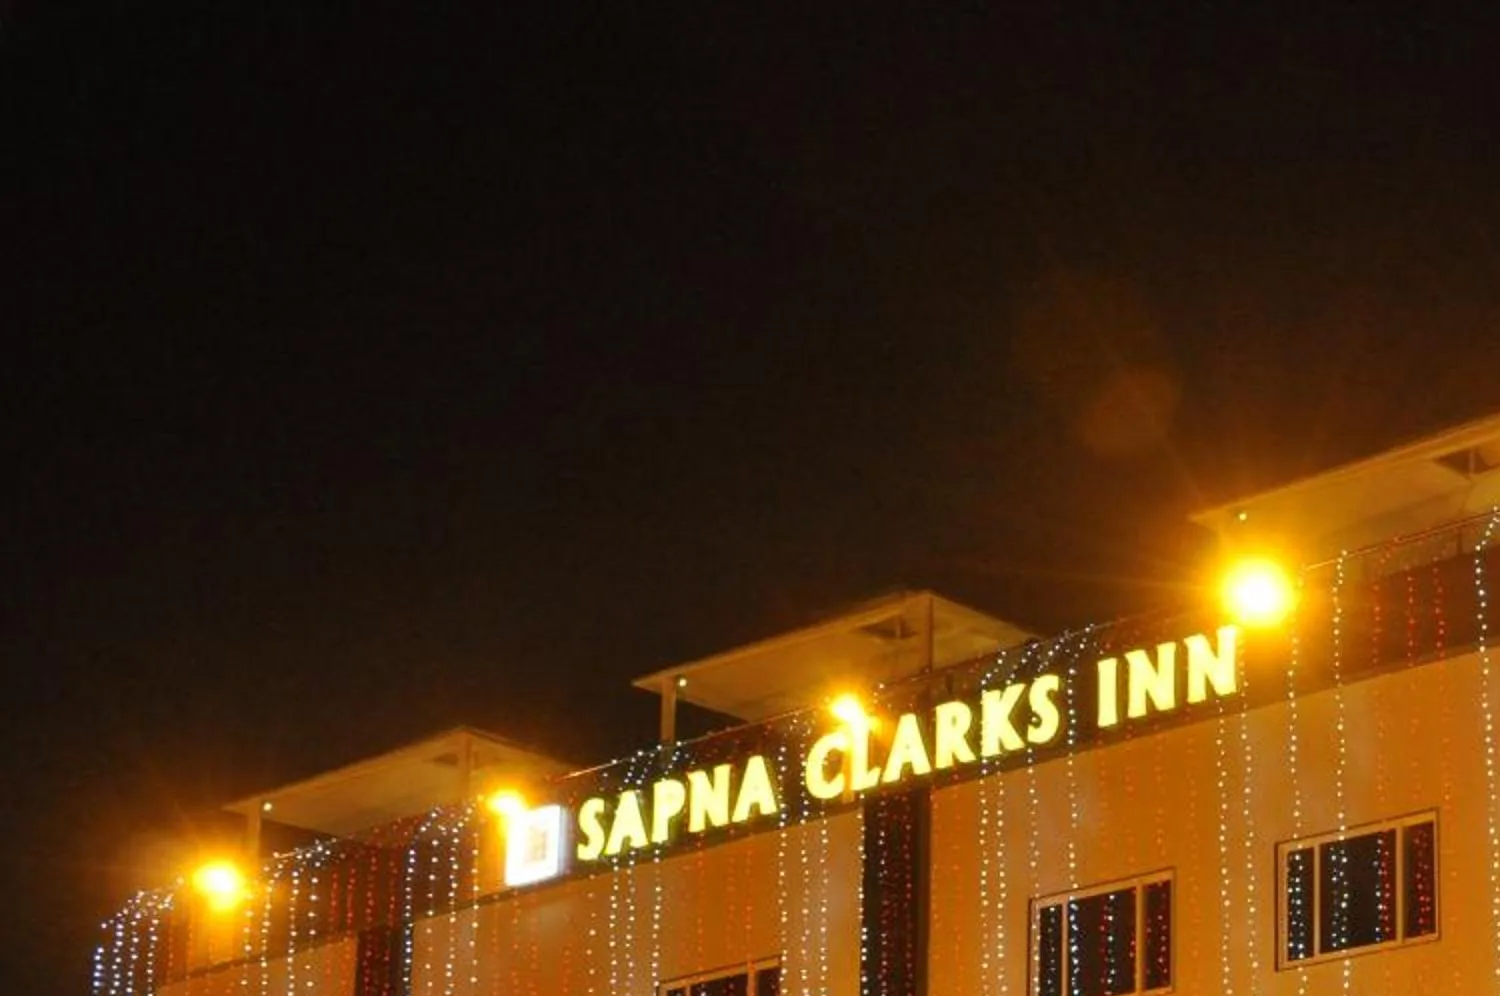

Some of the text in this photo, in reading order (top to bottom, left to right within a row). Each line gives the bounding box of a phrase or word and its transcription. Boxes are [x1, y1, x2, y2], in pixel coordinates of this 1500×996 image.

[577, 624, 1238, 861] SAPNA CLARKS INN
